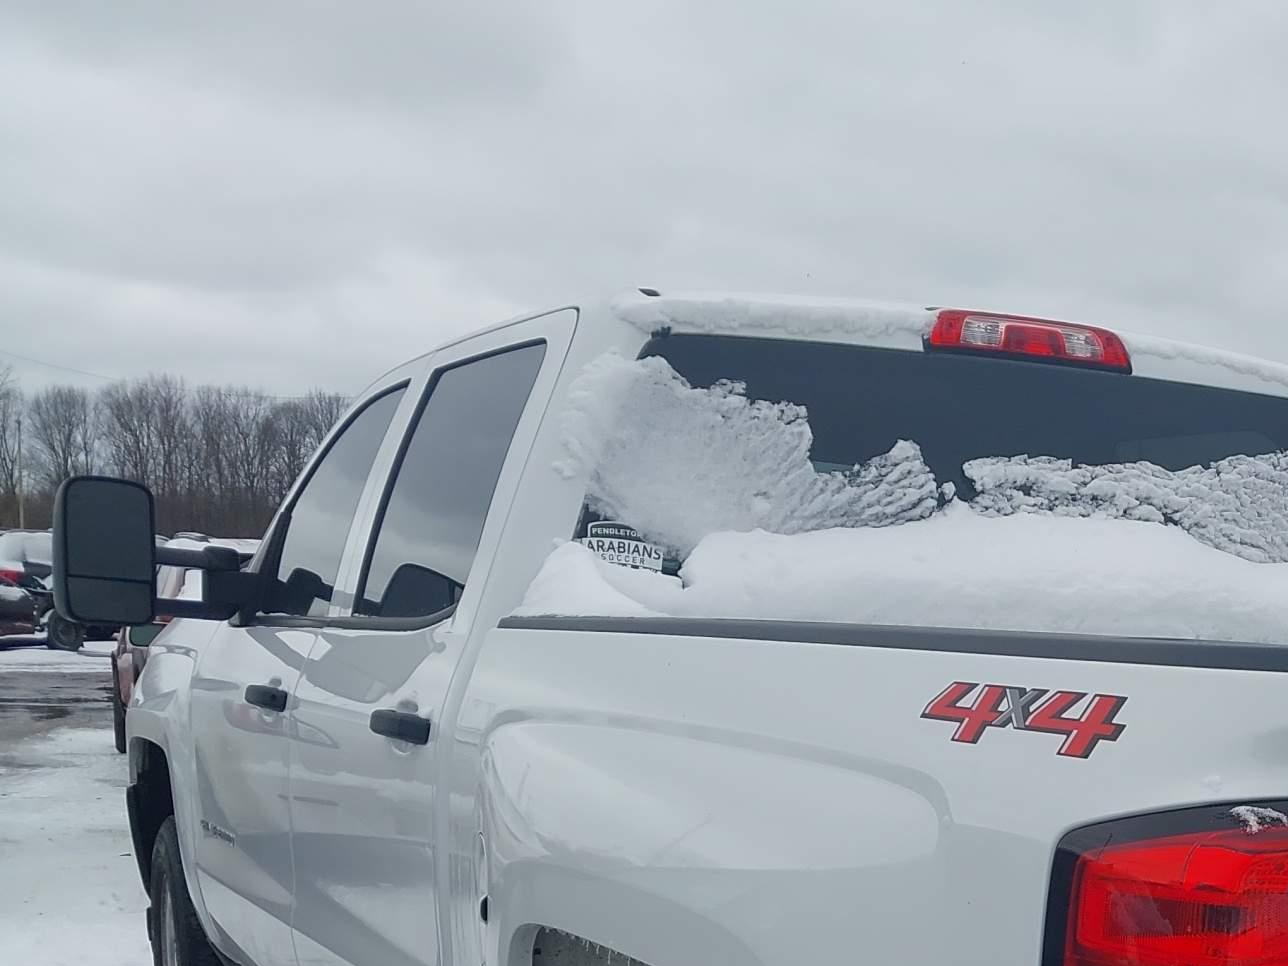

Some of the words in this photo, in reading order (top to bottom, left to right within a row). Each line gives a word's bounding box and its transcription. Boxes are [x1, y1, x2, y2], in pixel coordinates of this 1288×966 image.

[591, 526, 641, 538] PENDLETO
[587, 539, 661, 560] ARABIANS
[600, 552, 646, 564] SOCCER
